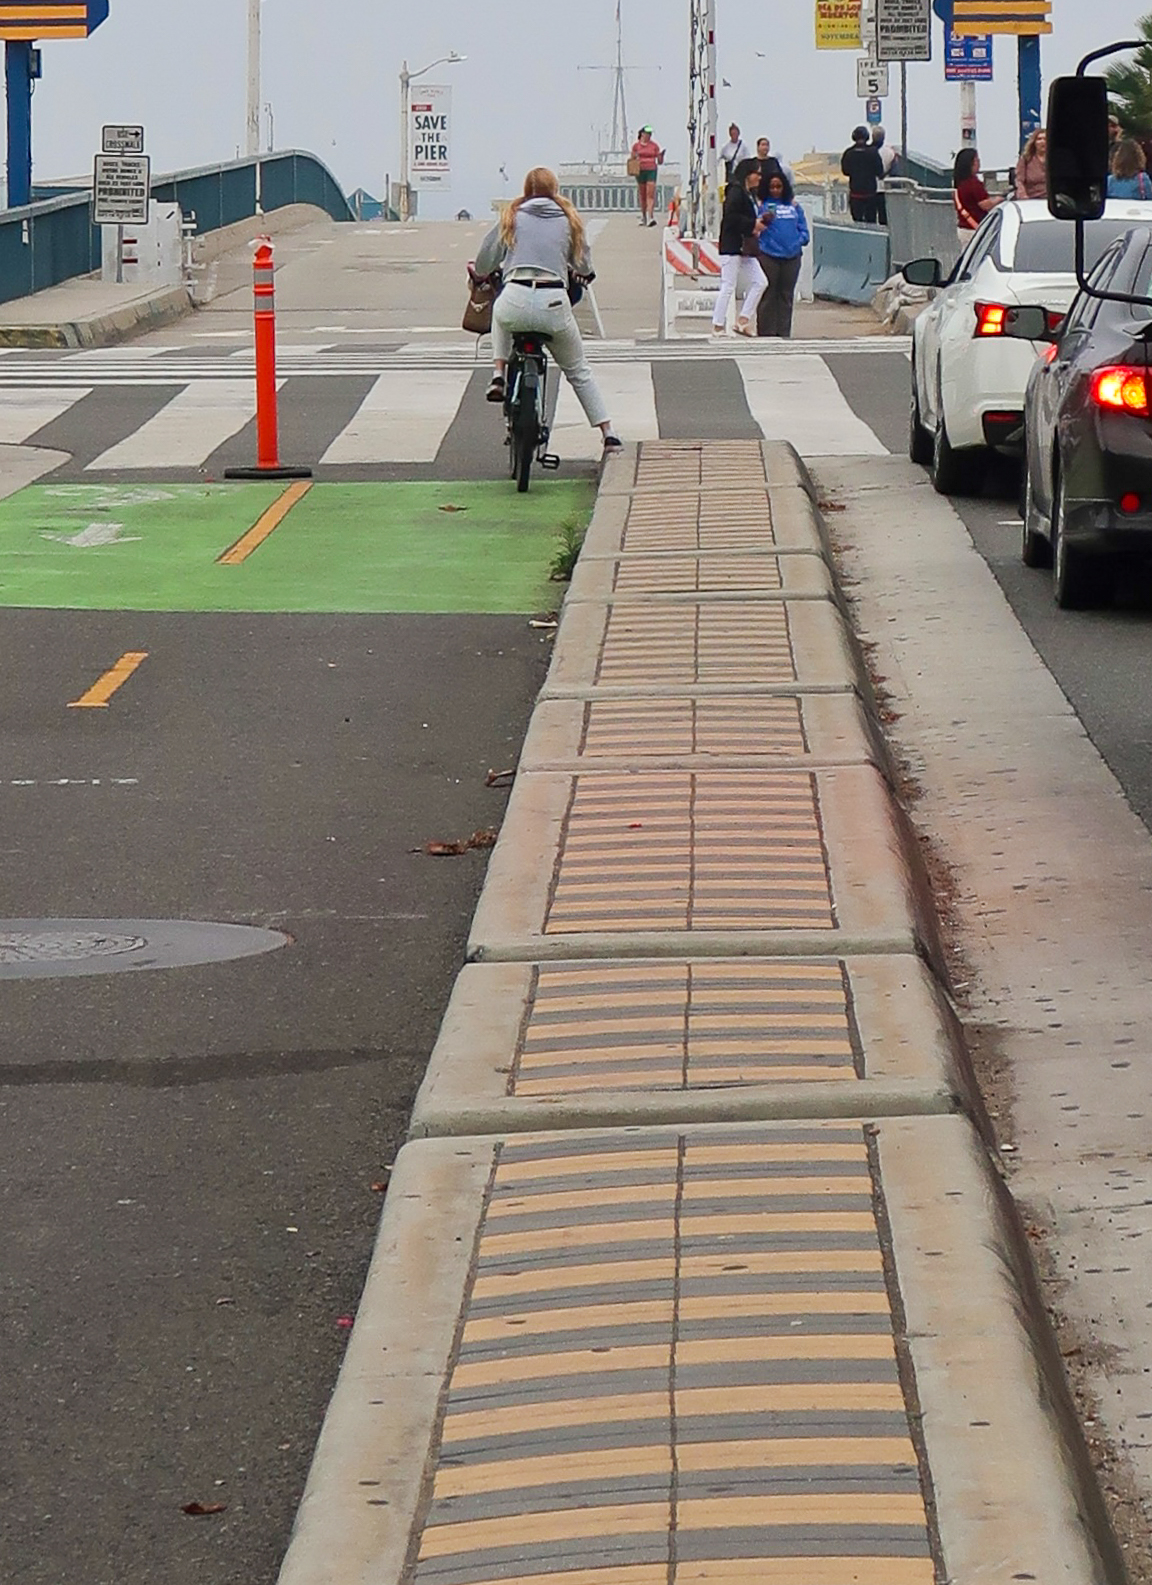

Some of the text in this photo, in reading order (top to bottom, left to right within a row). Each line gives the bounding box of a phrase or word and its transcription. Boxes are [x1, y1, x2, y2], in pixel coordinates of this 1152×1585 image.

[868, 79, 879, 94] 5
[414, 115, 447, 130] SAVE
[421, 132, 441, 143] THE
[414, 145, 448, 161] PIER
